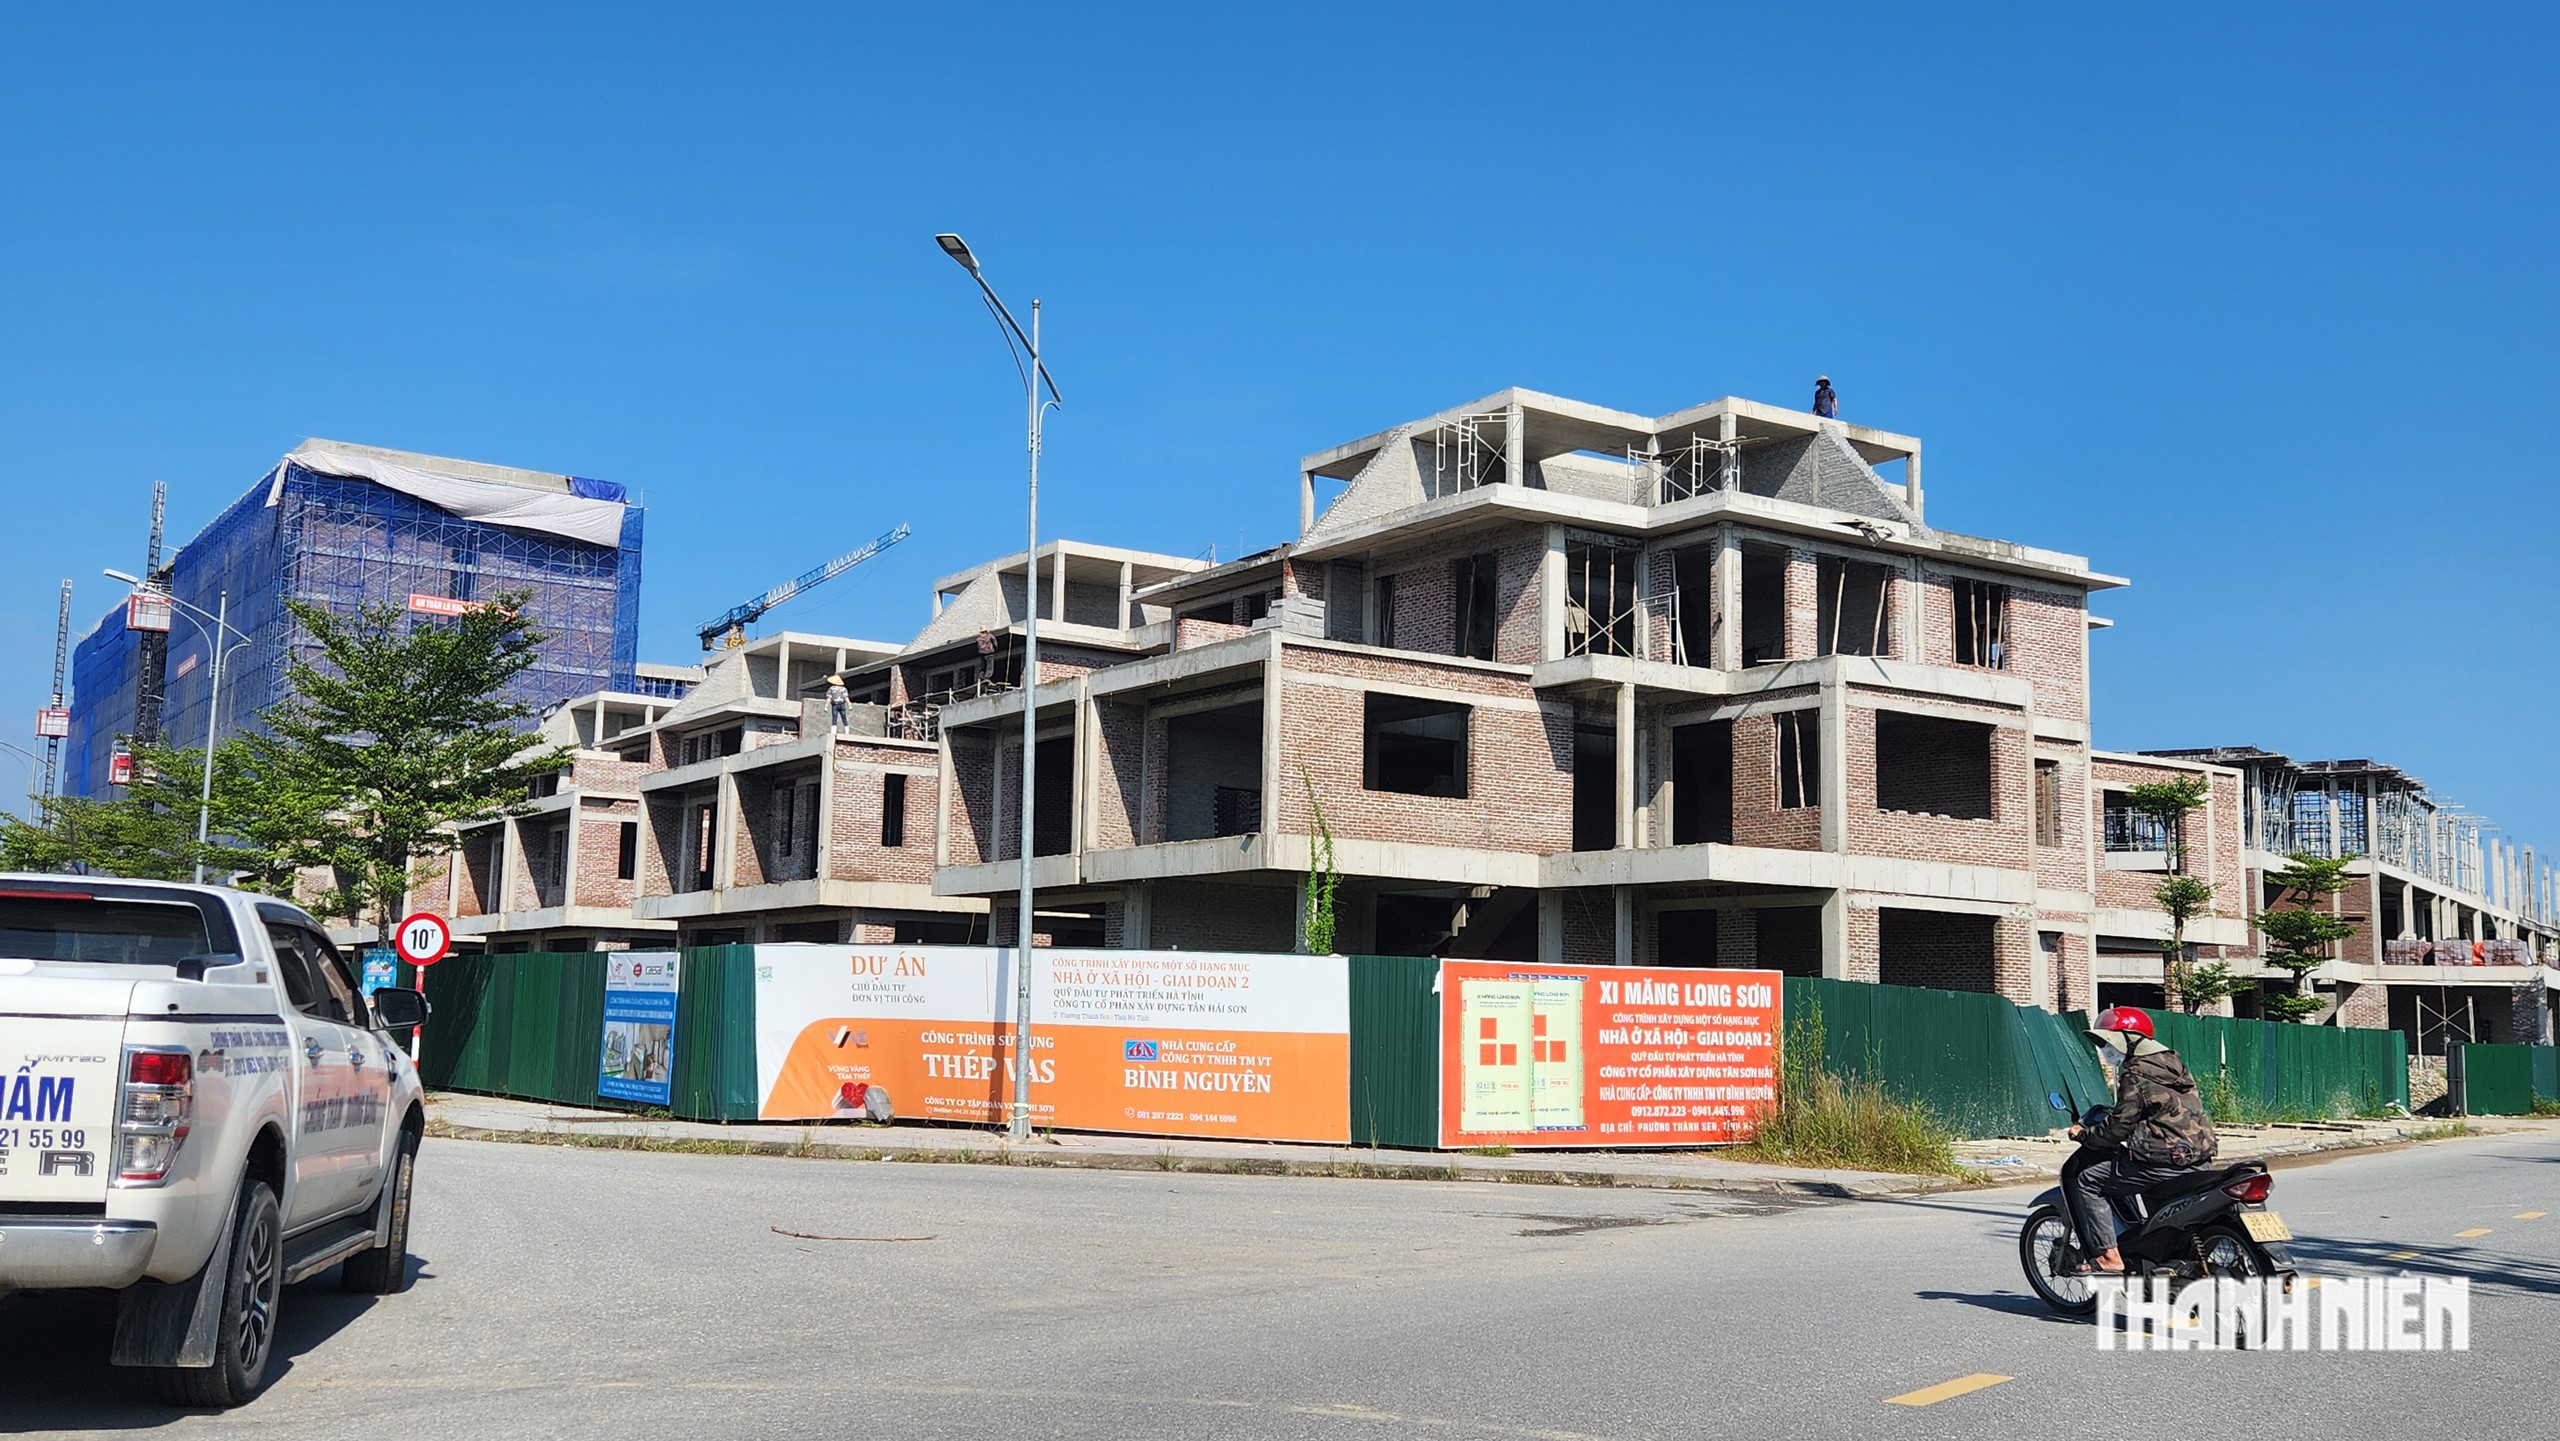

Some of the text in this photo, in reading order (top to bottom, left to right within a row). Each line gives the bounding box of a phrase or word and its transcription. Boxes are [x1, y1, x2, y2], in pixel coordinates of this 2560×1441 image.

[850, 950, 926, 981] DỰ ÁN
[1052, 957, 1250, 974] CÔNG TRÌNH XÂY DỰNG MỘT SỐ HẠNG MỤC
[1053, 968, 1083, 984] NHÀ
[1086, 969, 1098, 985] Ở
[1101, 970, 1121, 986] XÃ
[1124, 970, 1150, 989] HỘI
[1162, 974, 1192, 988] GIAI
[1196, 975, 1237, 992] ĐOẠN
[1241, 976, 1250, 989] 2
[902, 994, 926, 1004] CÔNG
[1053, 987, 1073, 998] QUỸ
[1094, 989, 1108, 998] TƯ
[1110, 988, 1134, 999] PHÁT
[1165, 990, 1179, 1001] HÀ
[1600, 978, 1772, 1009] XI MĂNG LONG SƠN
[1053, 997, 1079, 1008] CÔNG
[1080, 1000, 1093, 1009] TY
[1136, 1001, 1155, 1011] XÂY
[1157, 1002, 1186, 1014] DỰNG
[1187, 1002, 1206, 1013] TÂN
[1226, 1004, 1248, 1014] SƠN
[1613, 1013, 1760, 1028] CÔNG TRÌNH XÂY DỰNG MỘT SỐ HẠNG MỤC
[921, 1030, 955, 1043] CÔNG
[956, 1031, 995, 1045] TRÌNH
[1028, 1036, 1054, 1050] ỤNG
[1600, 1027, 1629, 1044] NHÀ
[1632, 1026, 1642, 1044] Ở
[1644, 1027, 1662, 1045] XÃ
[1664, 1028, 1688, 1049] HỘI
[1697, 1031, 1723, 1045] GIAI
[1726, 1032, 1762, 1049] ĐOẠN
[1764, 1033, 1772, 1046] 2
[1162, 1039, 1236, 1053] NHÀ CUNG CẤP
[25, 1055, 106, 1063] LIMITED
[922, 1049, 997, 1080] THÉP
[1162, 1053, 1272, 1067] CÔNG TY TNHH TM VT
[1124, 1065, 1272, 1094] BÌNH NGUYÊN
[1600, 1065, 1626, 1077] CÔNG
[1627, 1067, 1638, 1077] TY
[1678, 1066, 1696, 1078] XÂY
[1697, 1066, 1721, 1080] DỰNG
[1722, 1066, 1740, 1078] TÂN
[1741, 1067, 1757, 1078] SƠN
[0, 1060, 75, 1122] ẤM
[1600, 1085, 1616, 1100] NHÀ
[1616, 1087, 1636, 1101] CUNG
[1653, 1085, 1673, 1101] CÔNG
[1673, 1087, 1683, 1101] TY
[1684, 1087, 1704, 1101] TNHH
[1704, 1087, 1716, 1101] TM
[1716, 1087, 1726, 1101] VT
[1726, 1085, 1744, 1101] BÌNH
[925, 1097, 944, 1105] CÔNG
[1631, 1106, 1686, 1117] 0912.872.223
[1692, 1106, 1745, 1117] 0941.445.996
[1672, 1121, 1699, 1131] THÀNH
[29, 1129, 53, 1149] 55
[61, 1129, 85, 1149] 99
[2247, 1213, 2278, 1227] 38-P1
